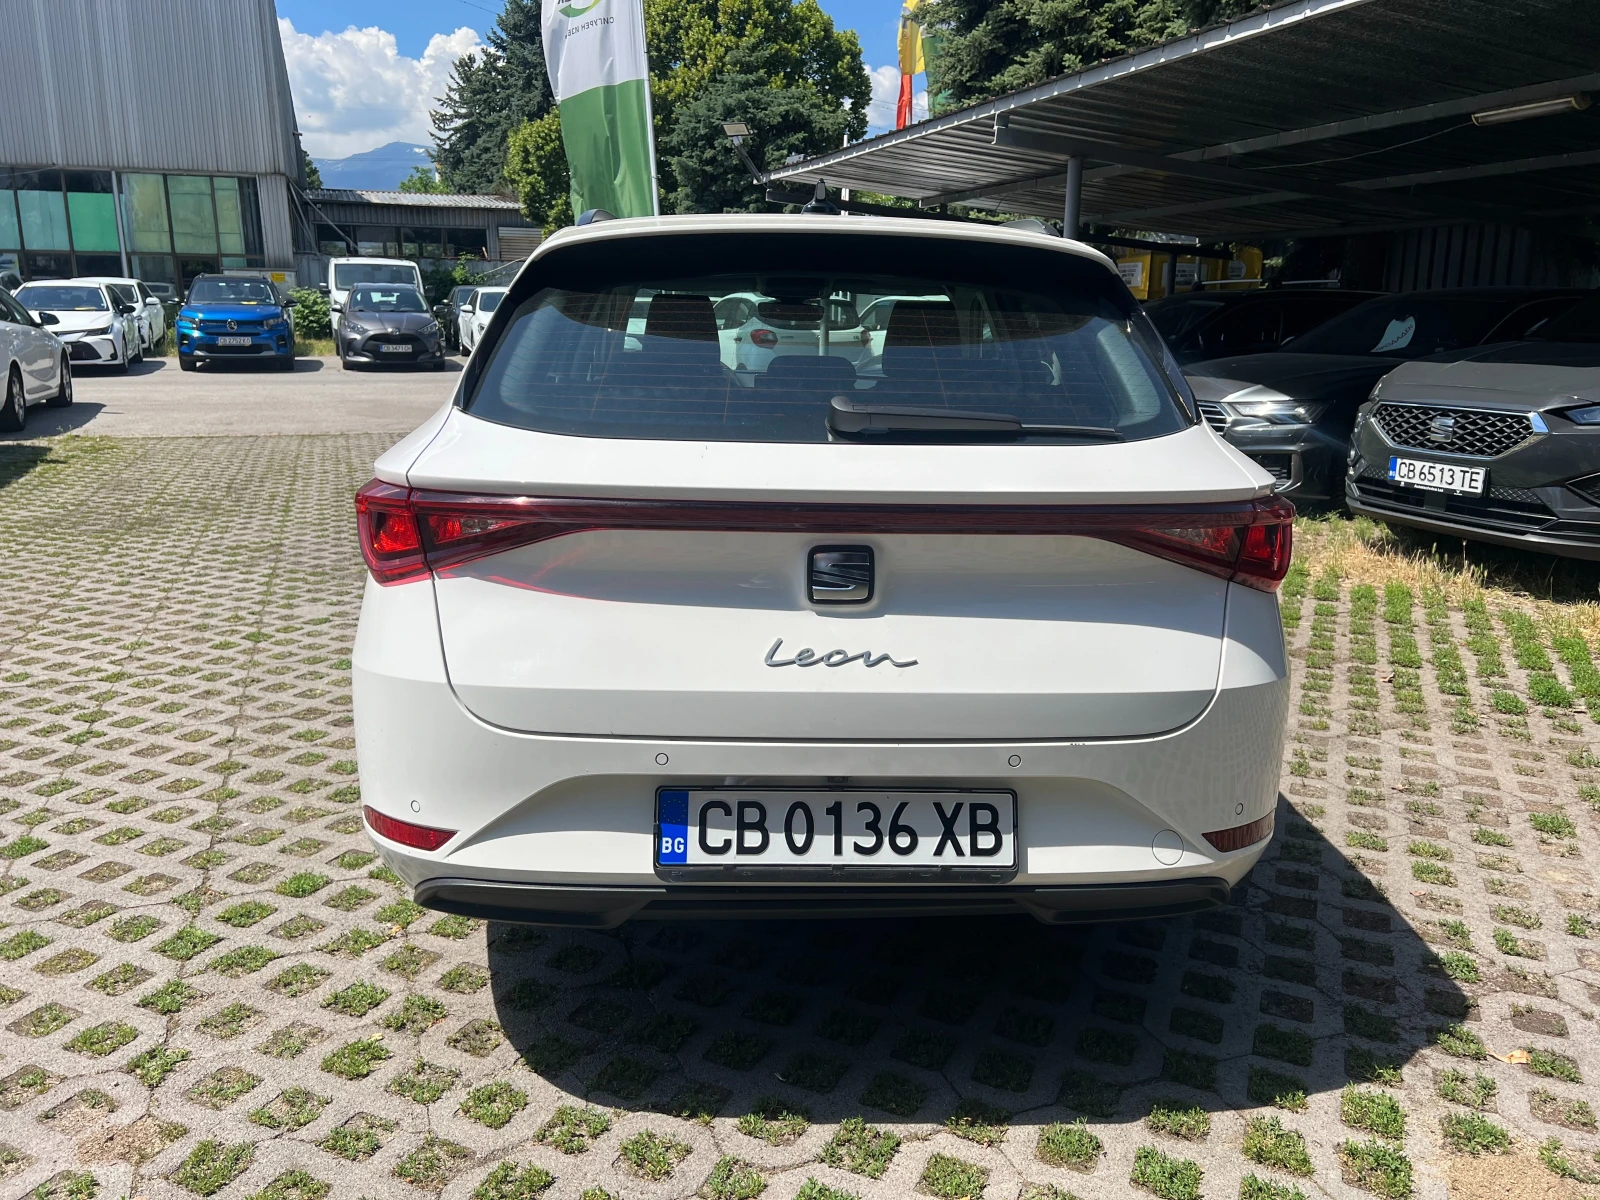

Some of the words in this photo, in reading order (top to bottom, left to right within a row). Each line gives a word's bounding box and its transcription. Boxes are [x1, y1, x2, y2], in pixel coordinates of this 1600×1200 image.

[1398, 462, 1416, 479] CB
[1419, 465, 1455, 485] 6513
[1460, 470, 1480, 489] TE
[764, 638, 919, 668] Leon
[698, 801, 770, 855] CB
[783, 801, 919, 856] 0136
[932, 802, 1003, 857] XB
[661, 837, 685, 853] BG
